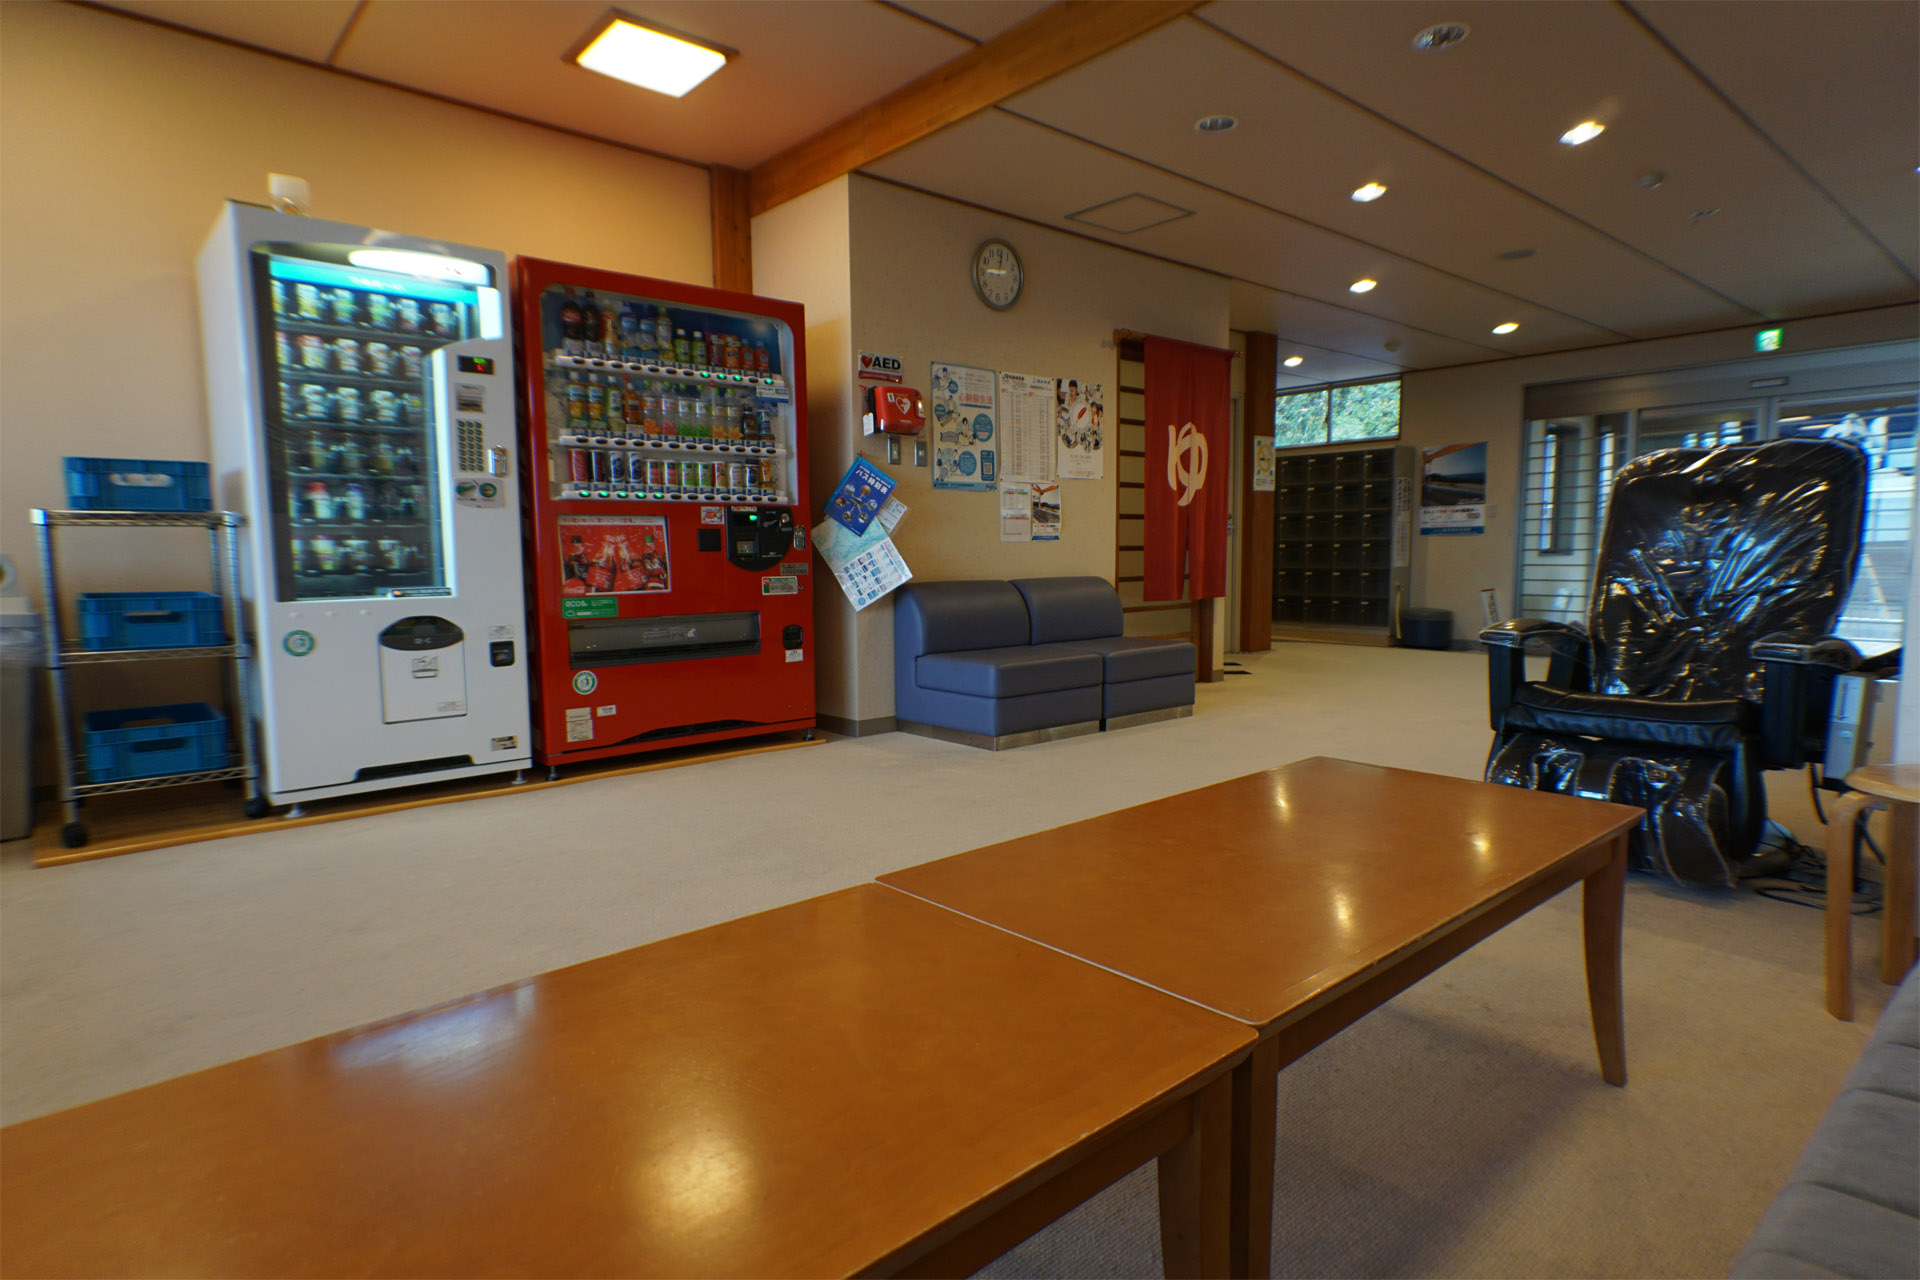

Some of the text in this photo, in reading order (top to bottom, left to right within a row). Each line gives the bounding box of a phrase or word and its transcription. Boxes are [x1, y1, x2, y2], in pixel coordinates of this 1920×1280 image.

[983, 256, 990, 265] 10
[872, 356, 901, 370] AED
[1167, 421, 1209, 507] ゆ
[855, 469, 888, 494] バス時刻表
